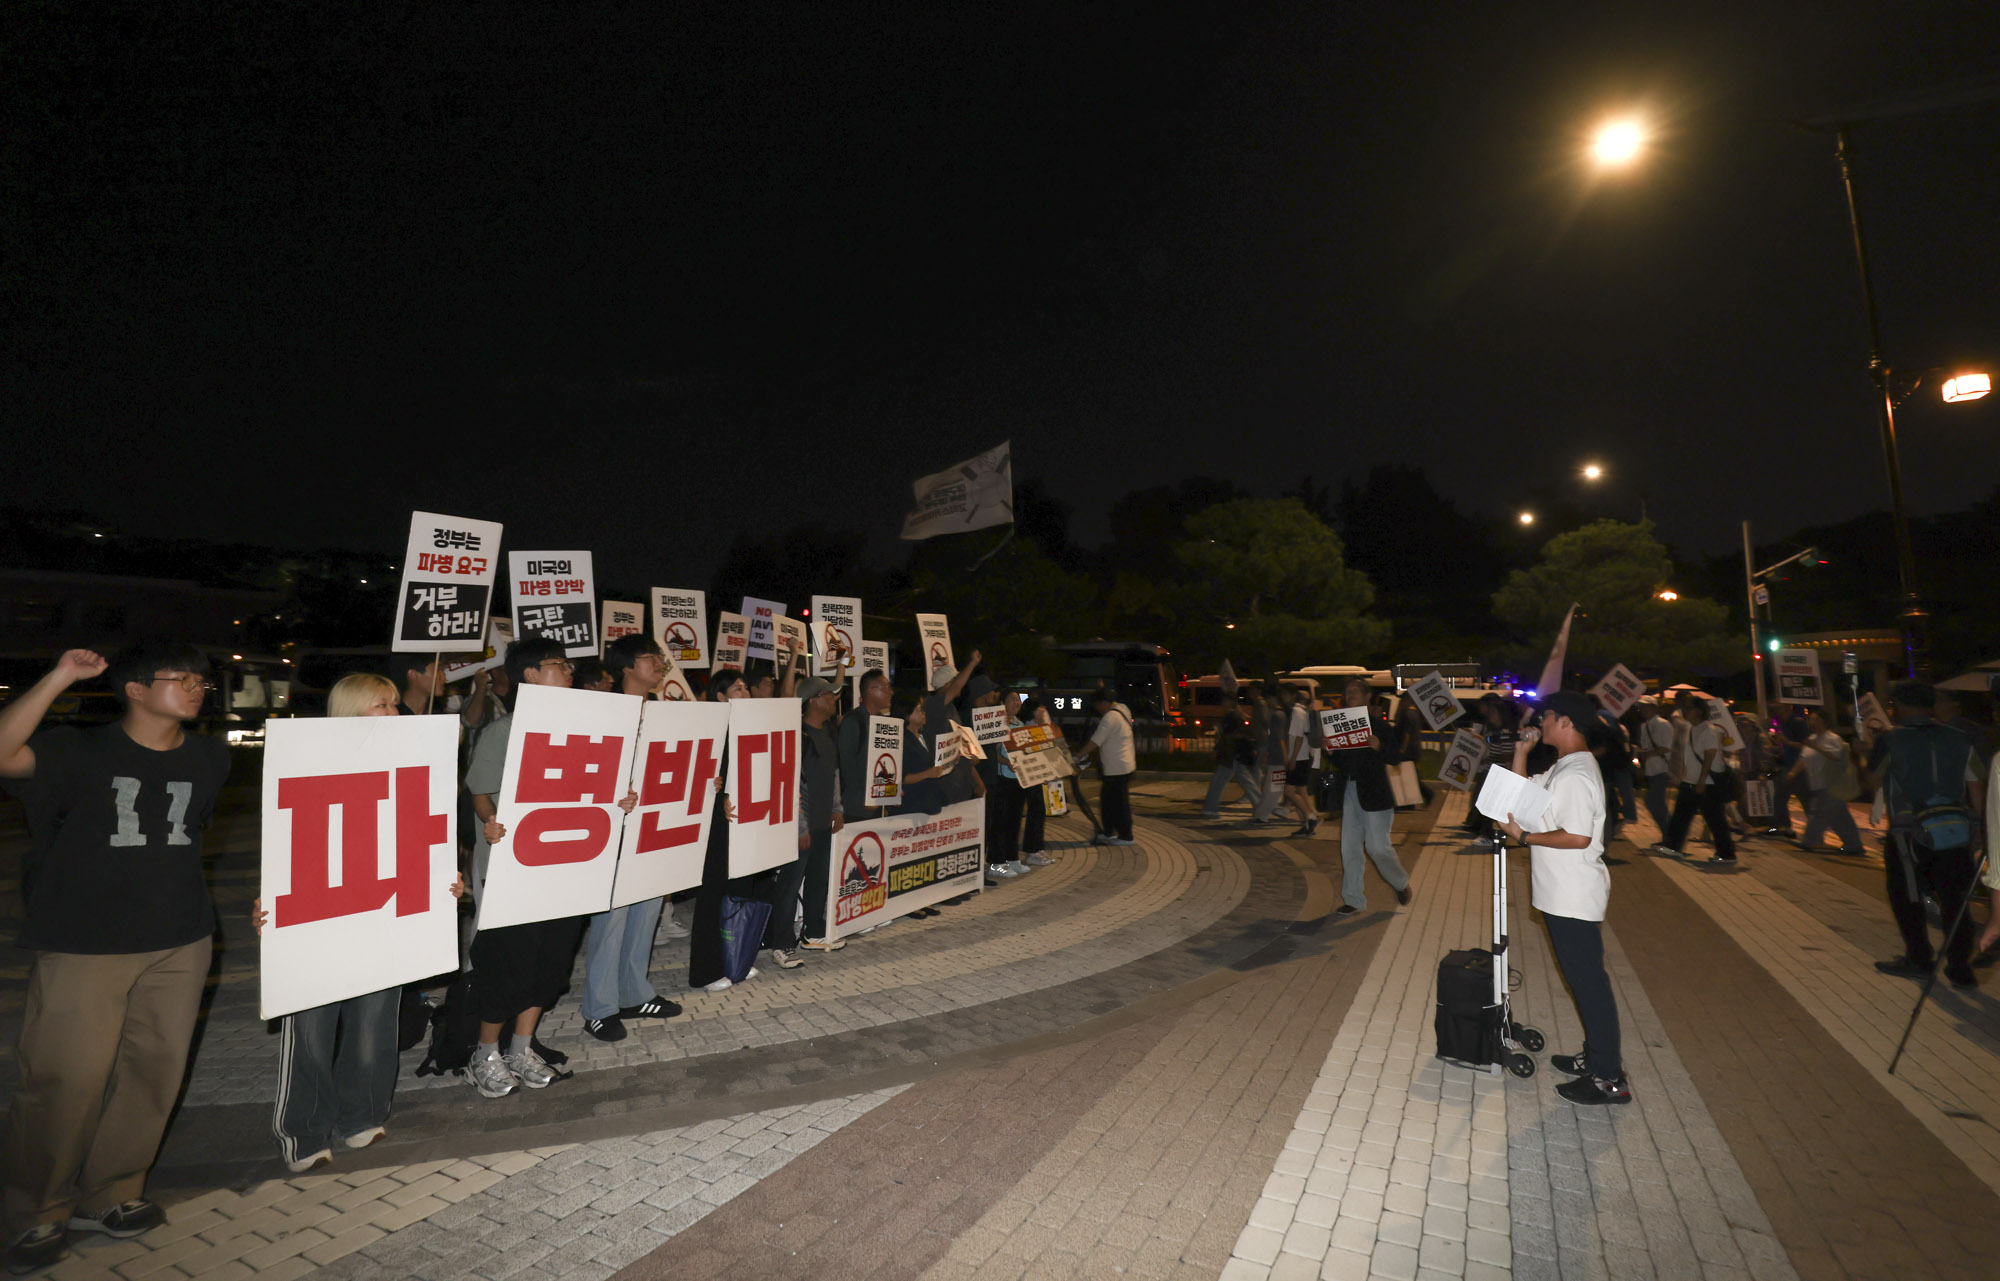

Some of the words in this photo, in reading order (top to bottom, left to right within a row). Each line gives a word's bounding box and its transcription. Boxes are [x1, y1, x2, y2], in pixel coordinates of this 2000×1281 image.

[433, 528, 481, 551] 정부는
[417, 552, 454, 574] 파병
[455, 556, 488, 576] 요구
[527, 560, 572, 575] 미국의
[519, 580, 552, 596] 파병
[554, 579, 585, 595] 압박
[413, 586, 457, 611] 거부
[661, 595, 696, 607] 파병논의
[661, 607, 698, 619] 중단하라!
[755, 606, 773, 617] NO
[822, 603, 853, 615] 침략전쟁
[428, 611, 480, 637] 하라!
[523, 605, 564, 630] 규탄
[613, 611, 635, 624] 정부는
[754, 632, 765, 640] TO
[862, 646, 884, 657] 략전쟁
[983, 711, 994, 719] NOT
[981, 722, 994, 730] WAR
[995, 720, 1002, 728] OF
[1332, 717, 1369, 733] 파병검토
[889, 860, 936, 892] 파병반대
[936, 848, 979, 880] 평화행진
[837, 884, 886, 922] 파병반대
